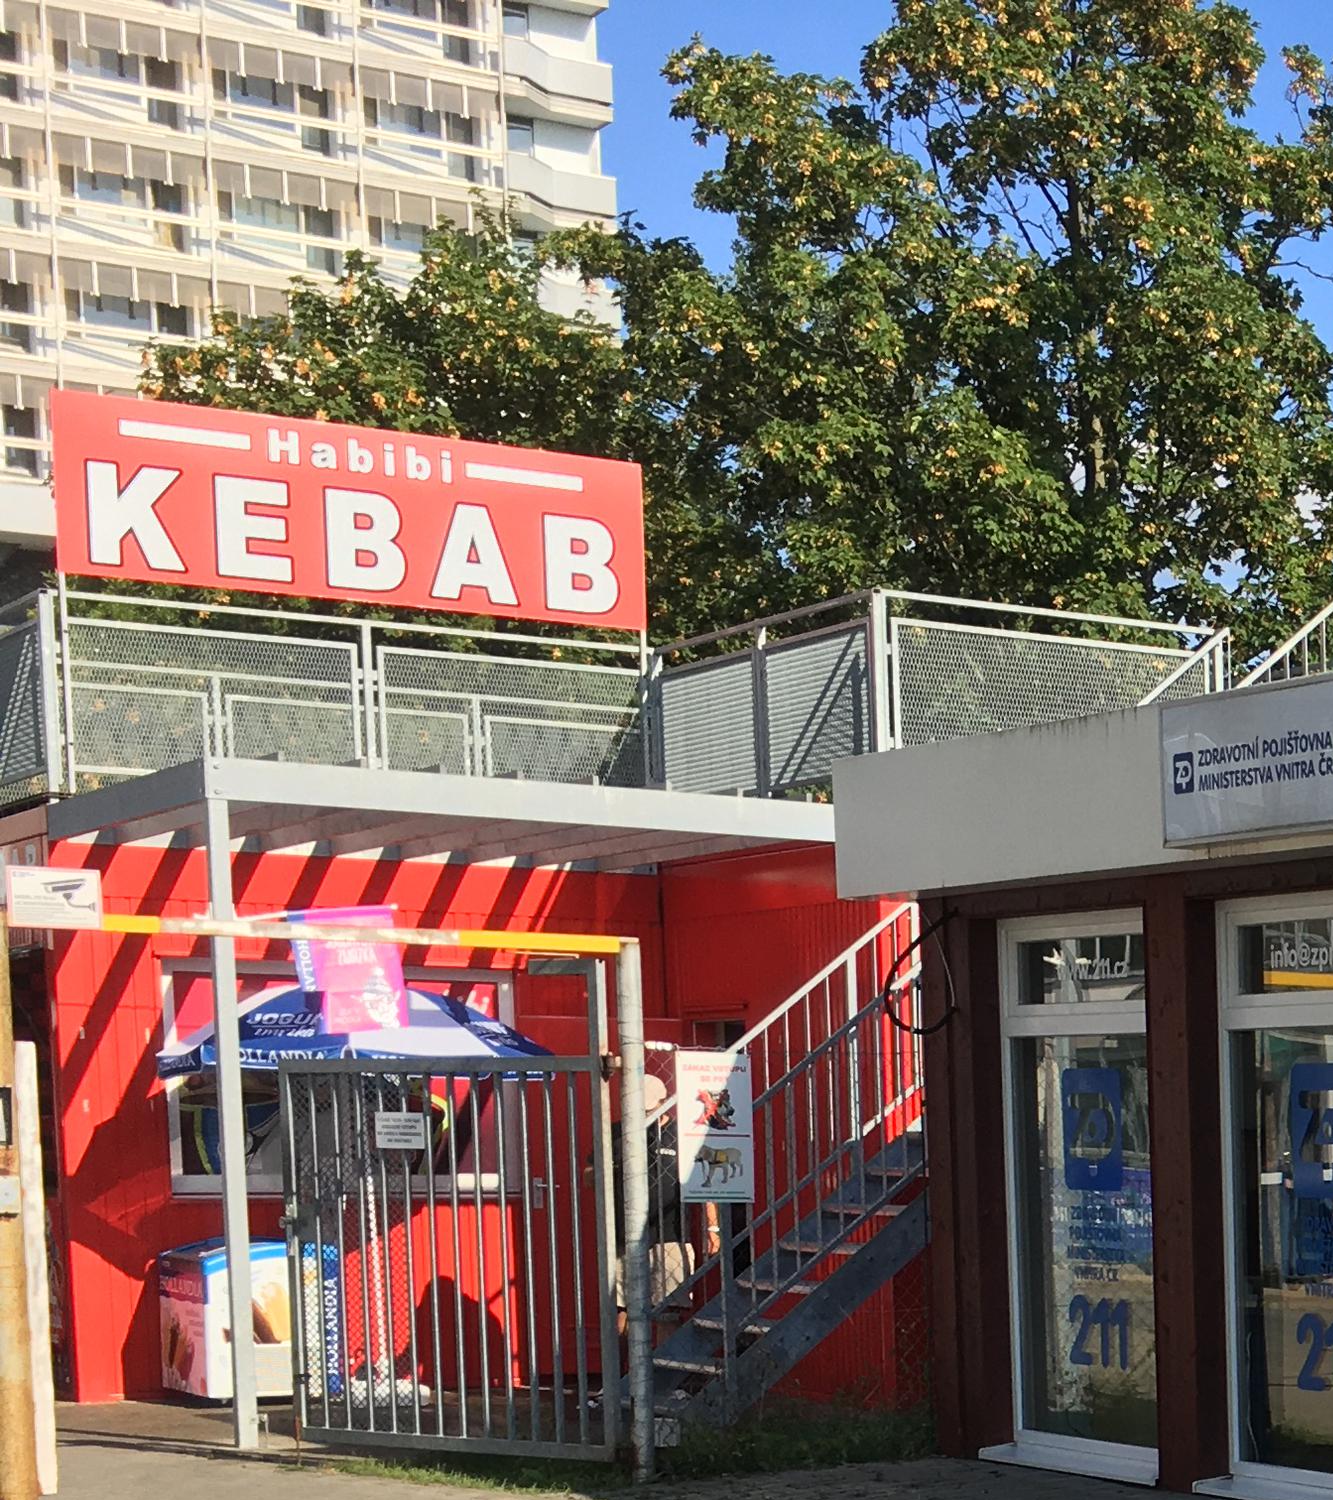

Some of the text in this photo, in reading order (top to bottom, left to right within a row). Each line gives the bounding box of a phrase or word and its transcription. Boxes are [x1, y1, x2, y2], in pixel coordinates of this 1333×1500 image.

[267, 428, 454, 484] Habibi
[84, 457, 621, 615] KEBAB
[1197, 735, 1259, 767] ZDRAVOTNÍ
[1263, 729, 1333, 758] POJIŠŤOVNA
[1197, 753, 1333, 791] MINISTERSTVA VNITRA ČR
[1069, 1294, 1129, 1371] 211
